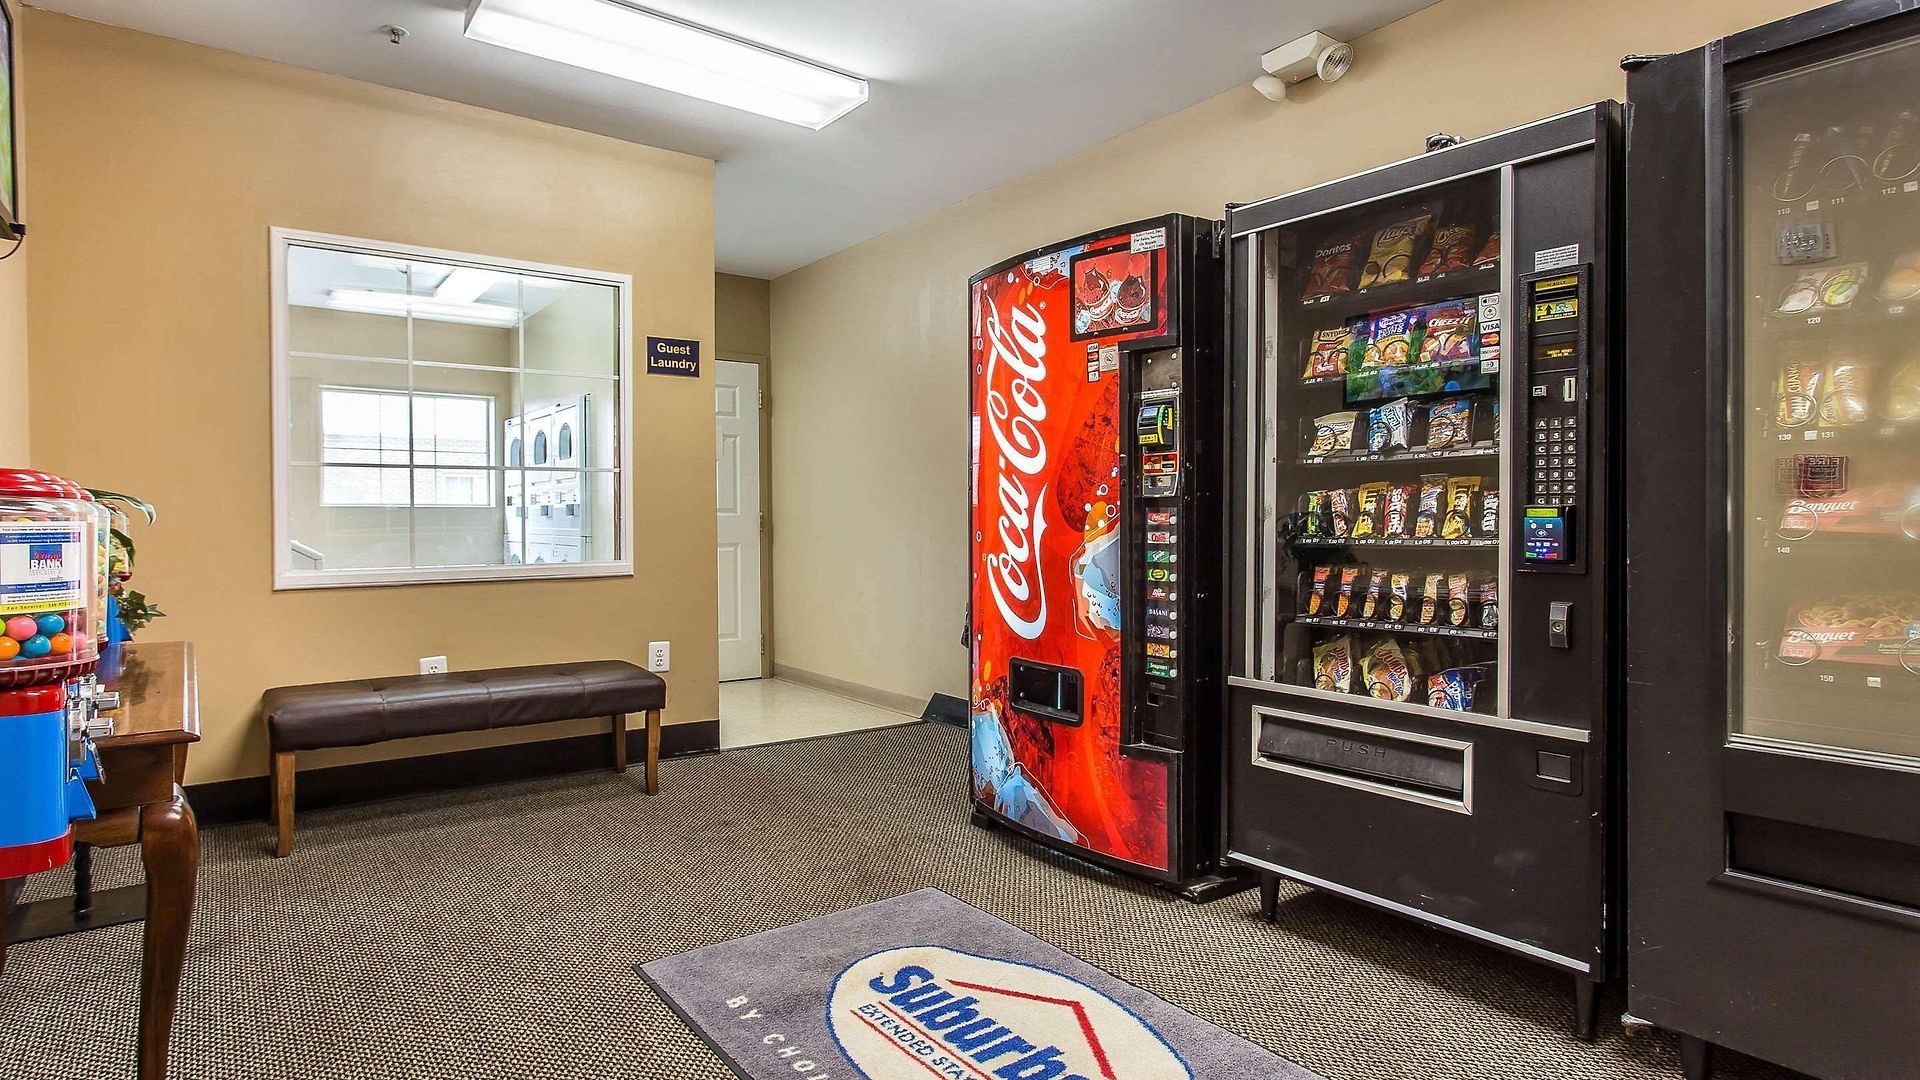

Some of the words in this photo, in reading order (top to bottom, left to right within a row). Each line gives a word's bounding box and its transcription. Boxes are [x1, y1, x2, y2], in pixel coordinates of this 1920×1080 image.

[1315, 244, 1352, 258] Doritos
[1807, 316, 1820, 324] 120
[657, 342, 690, 355] Guest
[650, 356, 696, 372] Laundry
[1821, 431, 1834, 439] 131
[986, 294, 1049, 640] Coca-Cola
[1788, 500, 1859, 514] Banquet
[1777, 546, 1790, 554] 140
[30, 560, 62, 569] BANK
[1787, 630, 1860, 644] Banquet
[1326, 738, 1386, 759] PUSH
[726, 995, 761, 1020] BY
[858, 1003, 935, 1056] EXTENDED
